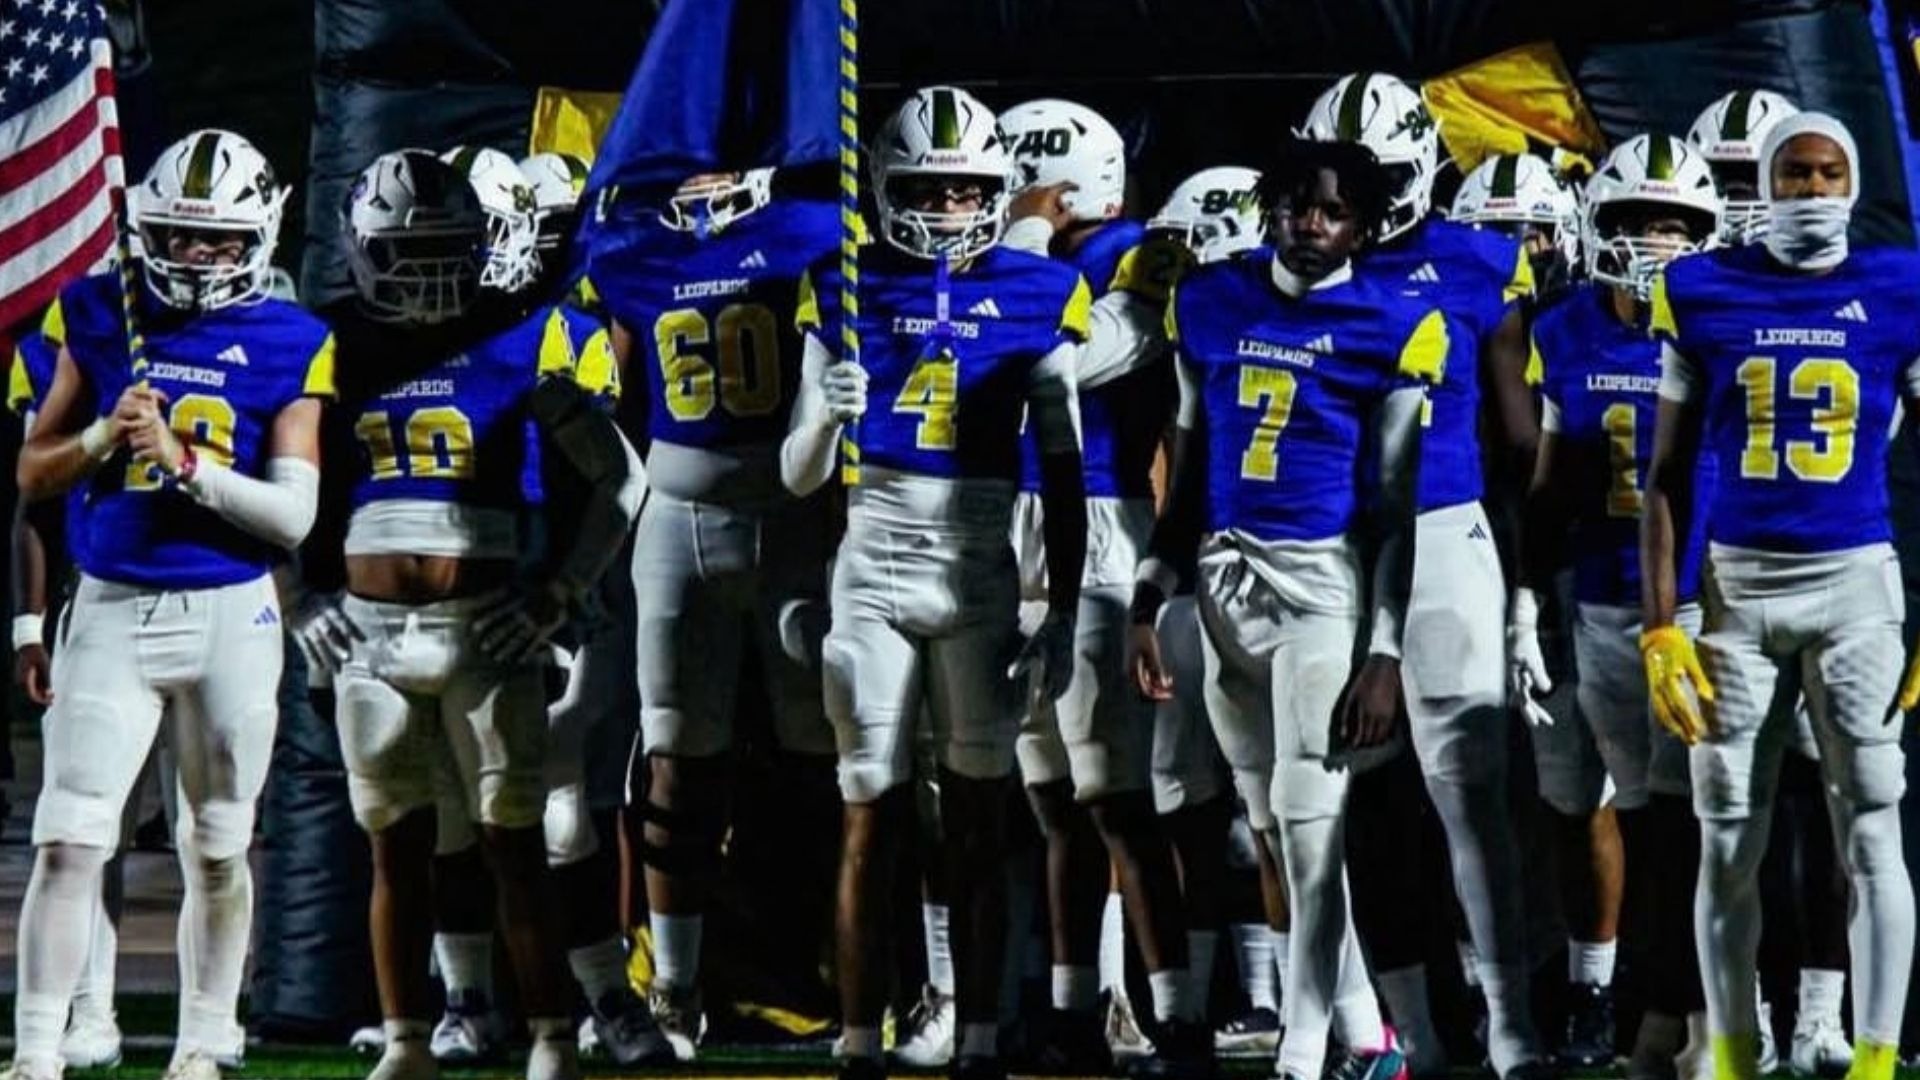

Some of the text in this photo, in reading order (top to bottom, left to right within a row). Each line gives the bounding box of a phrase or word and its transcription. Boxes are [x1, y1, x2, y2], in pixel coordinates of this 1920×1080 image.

[654, 303, 780, 422] 60
[1238, 339, 1316, 368] LEOPARDS
[1755, 328, 1847, 347] LEOPARDS
[354, 405, 475, 481] 10
[892, 348, 960, 450] 4
[1238, 364, 1297, 481] 7
[1736, 355, 1861, 483] 13
[1602, 403, 1645, 517] 1
